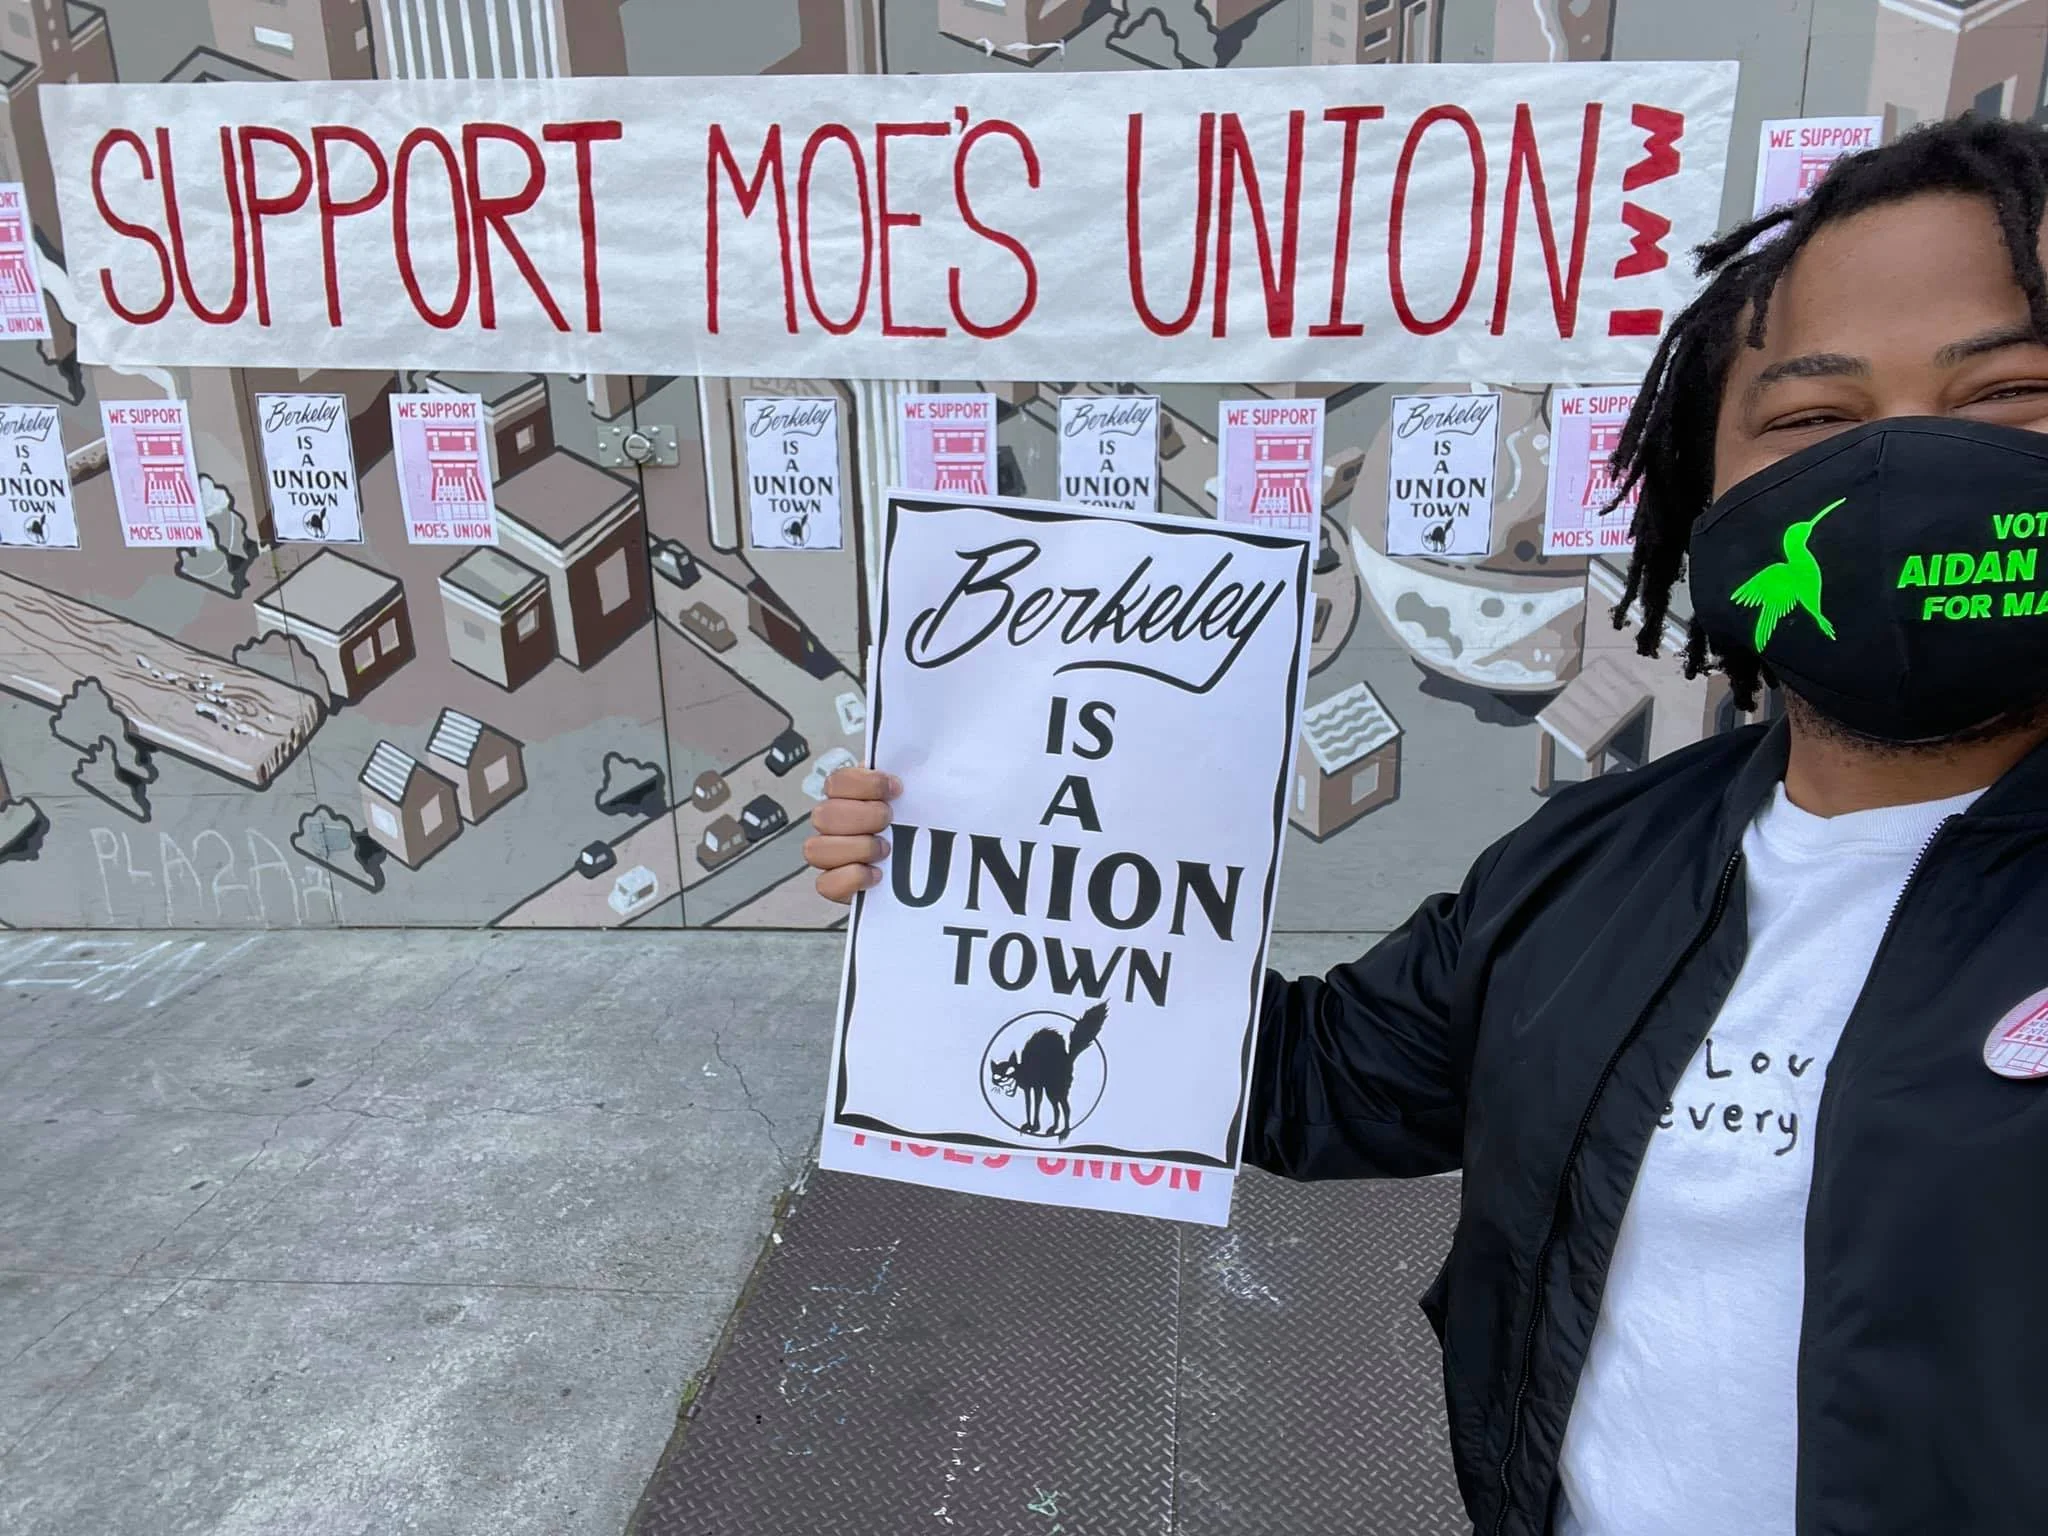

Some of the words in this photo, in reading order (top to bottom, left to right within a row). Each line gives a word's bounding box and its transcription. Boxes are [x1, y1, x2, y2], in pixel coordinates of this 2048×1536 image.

[1770, 130, 1795, 147] WE
[1800, 127, 1872, 147] SUPPORT
[91, 120, 622, 332] SUPPORT
[705, 105, 1040, 340] MOE'S
[1126, 102, 1603, 338] UNION
[7, 317, 44, 333] UNION
[398, 402, 417, 418] WE
[420, 402, 476, 418] SUPPORT
[905, 403, 925, 418] WE
[930, 402, 989, 418] SUPPORT
[1562, 398, 1584, 415] WE
[108, 408, 127, 424] WE
[132, 408, 181, 424] SUPPORT
[265, 401, 341, 433] Berkeley
[750, 403, 832, 438] Berkeley
[1064, 402, 1152, 437] Berkeley
[1227, 409, 1249, 426] WE
[1252, 408, 1317, 425] SUPPORT
[1397, 400, 1493, 438] Berkeley
[297, 436, 312, 450] IS
[783, 440, 799, 455] IS
[1099, 440, 1115, 455] IS
[1434, 441, 1451, 456] IS
[15, 445, 30, 459] IS
[20, 462, 32, 475] A
[302, 454, 315, 467] A
[786, 459, 800, 473] A
[1101, 459, 1114, 473] A
[1434, 460, 1449, 474] A
[272, 470, 347, 490] UNION
[754, 475, 833, 496] UNION
[1065, 476, 1149, 497] UNION
[1396, 477, 1487, 499] UNION
[8, 499, 56, 514] TOWN
[288, 492, 338, 507] TOWN
[768, 498, 821, 513] TOWN
[1411, 503, 1470, 518] TOWN
[166, 526, 203, 540] UNION
[453, 524, 492, 540] UNION
[1897, 549, 2038, 588] AIDAN
[1922, 594, 1992, 620] FOR
[905, 538, 1286, 694] Berkeley
[1046, 697, 1117, 760] IS
[1040, 774, 1103, 833] A
[891, 823, 1245, 942] UNION
[943, 926, 1172, 1008] TOWN
[1657, 1102, 1798, 1156] every
